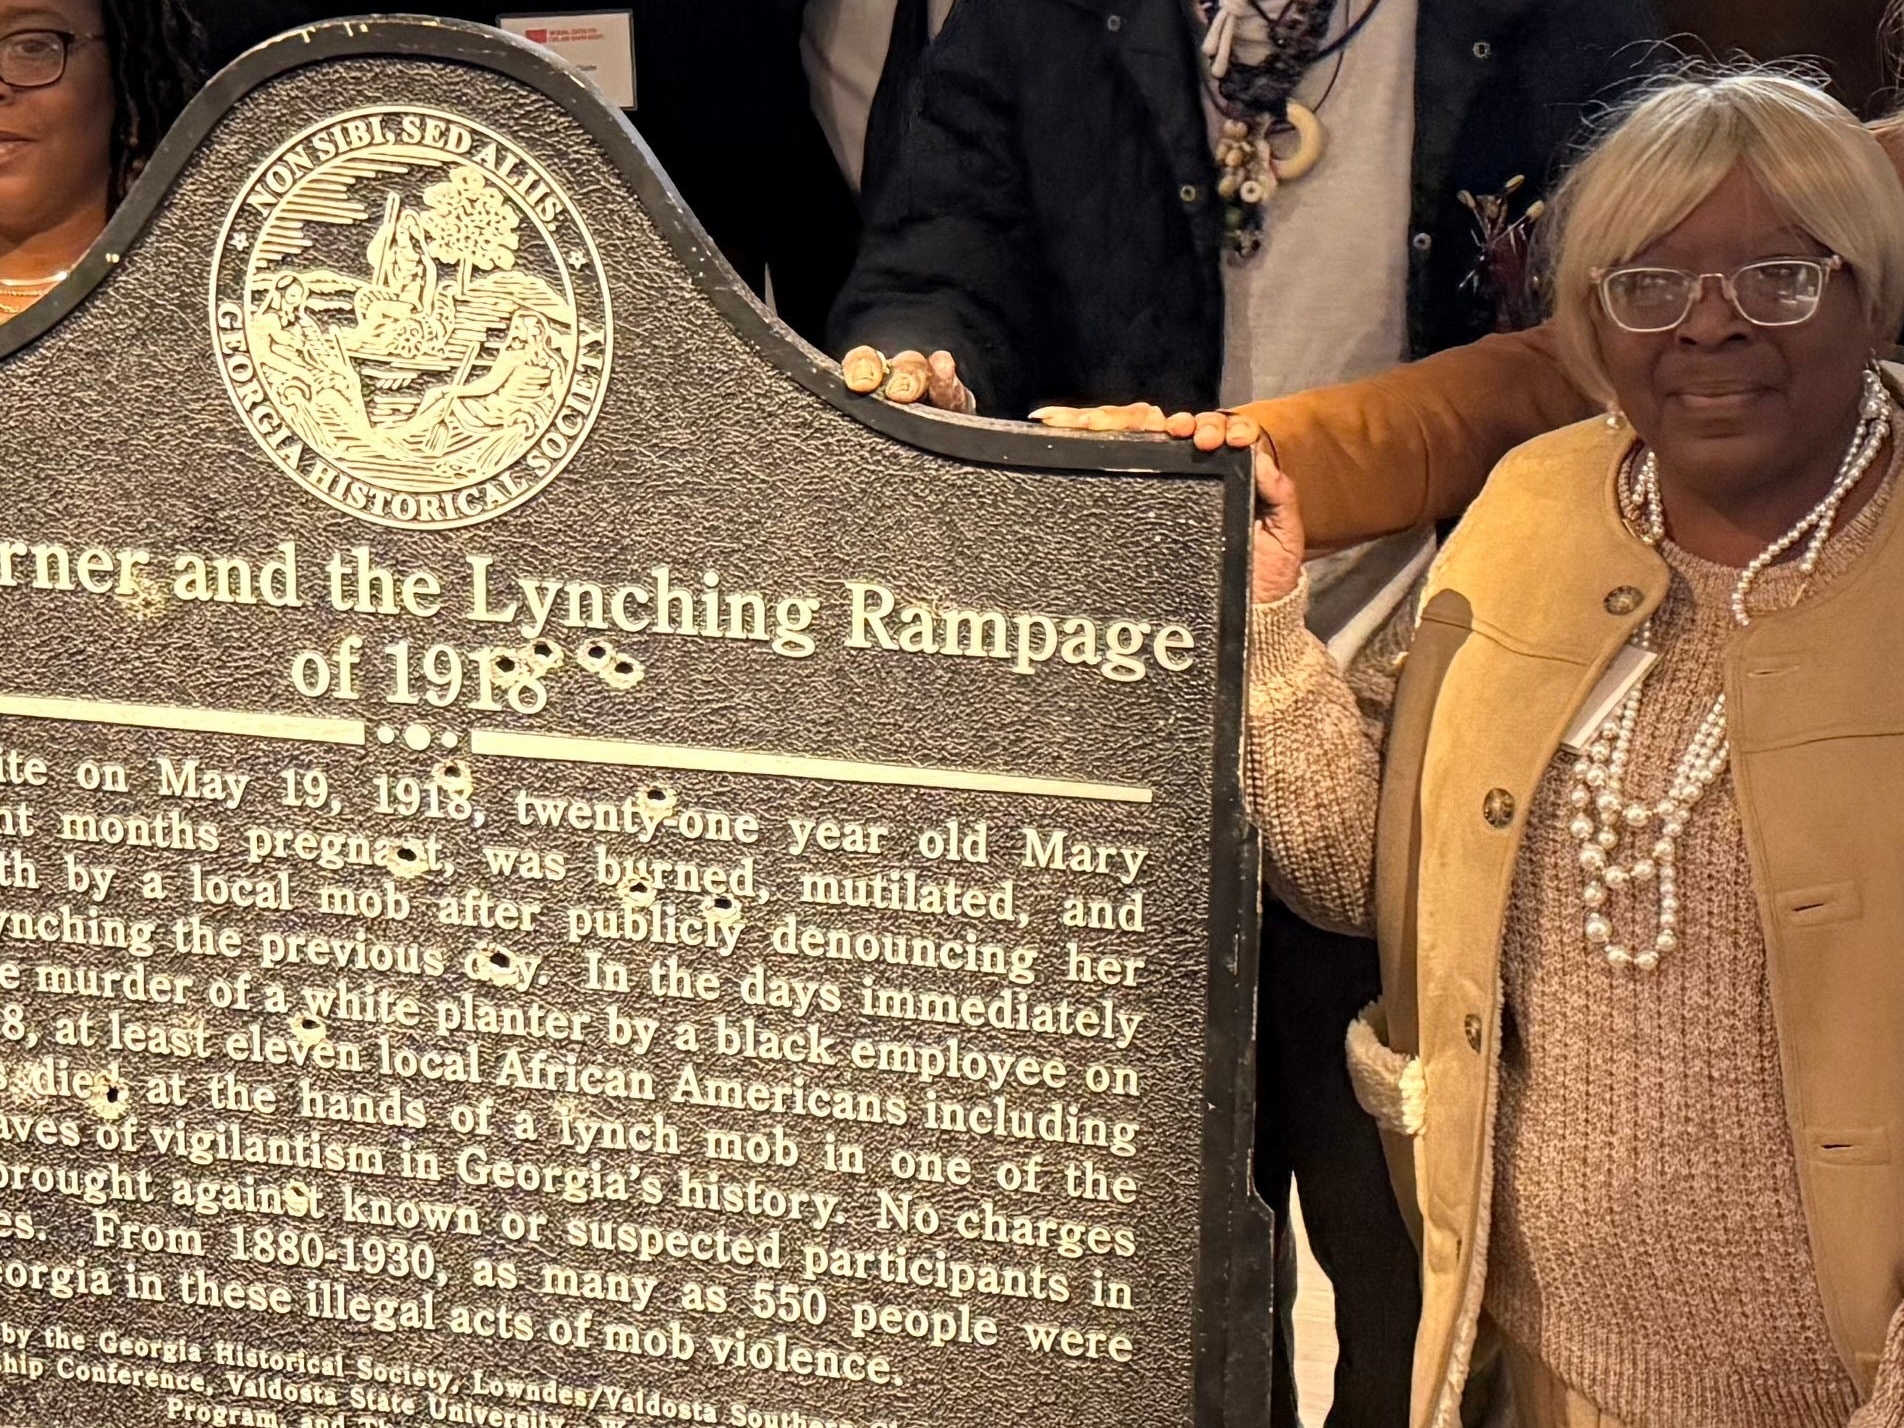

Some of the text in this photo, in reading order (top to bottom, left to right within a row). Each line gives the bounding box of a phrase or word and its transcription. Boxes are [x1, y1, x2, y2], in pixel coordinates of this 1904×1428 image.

[246, 143, 316, 218] NON
[402, 114, 472, 154] SED
[216, 301, 605, 522] GEORGIA HISTORICAL SOCIETY
[173, 543, 301, 608] and
[326, 547, 441, 618] the
[465, 555, 820, 658] Lynching
[845, 580, 1194, 682] Rampage
[291, 637, 364, 701] of
[60, 811, 220, 852] months
[482, 846, 566, 881] was
[799, 870, 1029, 930] mutilated,
[1061, 890, 1146, 932] and
[75, 761, 129, 793] on
[157, 758, 252, 811] May
[279, 767, 342, 818] 19,
[514, 791, 760, 845] twenty-one
[788, 818, 888, 857] year
[917, 820, 988, 863] old
[1021, 826, 1147, 885] Mary
[67, 855, 118, 904] by
[190, 865, 294, 911] local
[318, 881, 411, 921] mob
[436, 887, 541, 932] after
[567, 901, 746, 959] publicly
[772, 914, 1037, 985] denouncing
[1067, 940, 1145, 987] her
[174, 916, 243, 958] the
[259, 930, 445, 976] previous
[585, 950, 631, 992] In
[650, 958, 720, 1001] the
[740, 964, 842, 1018] days
[861, 975, 1143, 1049] immediately
[35, 962, 194, 1005] murder
[207, 971, 253, 1010] of
[303, 981, 419, 1026] white
[434, 992, 591, 1042] planter
[607, 1006, 660, 1057] by
[718, 1016, 836, 1065] black
[850, 1038, 1068, 1092] employee
[1084, 1062, 1141, 1096] on
[53, 1014, 94, 1047] at
[108, 1012, 213, 1058] least
[224, 1025, 363, 1072] eleven
[379, 1037, 483, 1084] local
[495, 1048, 655, 1101] African
[671, 1065, 909, 1126] Americans
[925, 1090, 1140, 1158] including
[96, 1113, 140, 1151] of
[147, 1118, 385, 1176] vigilantism
[399, 1140, 441, 1181] in
[456, 1146, 663, 1205] Georgia's
[678, 1169, 847, 1231] history.
[876, 1190, 940, 1235] No
[956, 1202, 1137, 1260] charges
[144, 1073, 189, 1106] at
[208, 1073, 277, 1115] the
[297, 1080, 428, 1129] hands
[705, 1127, 799, 1167] mob
[822, 1132, 866, 1174] in
[891, 1149, 972, 1185] one
[1065, 1159, 1139, 1203] the
[91, 1210, 205, 1257] From
[230, 1224, 449, 1291] 1880-1930,
[541, 1267, 658, 1314] many
[752, 1280, 827, 1325] 550
[852, 1301, 998, 1349] people
[1021, 1321, 1133, 1362] were
[342, 1185, 482, 1236] known
[566, 1219, 782, 1269] suspected
[801, 1244, 1070, 1303] participants
[1091, 1268, 1134, 1310] in
[0, 1321, 32, 1350] by
[42, 1326, 87, 1351] the
[97, 1330, 201, 1366] Georgia
[214, 1343, 345, 1379] Historical
[124, 1262, 166, 1302] in
[178, 1269, 292, 1315] these
[305, 1281, 437, 1334] illegal
[449, 1306, 534, 1341] acts
[547, 1309, 593, 1348] of
[604, 1320, 695, 1360] mob
[709, 1328, 904, 1385] violence.
[225, 1375, 338, 1409] Valdosta
[348, 1388, 416, 1418] State
